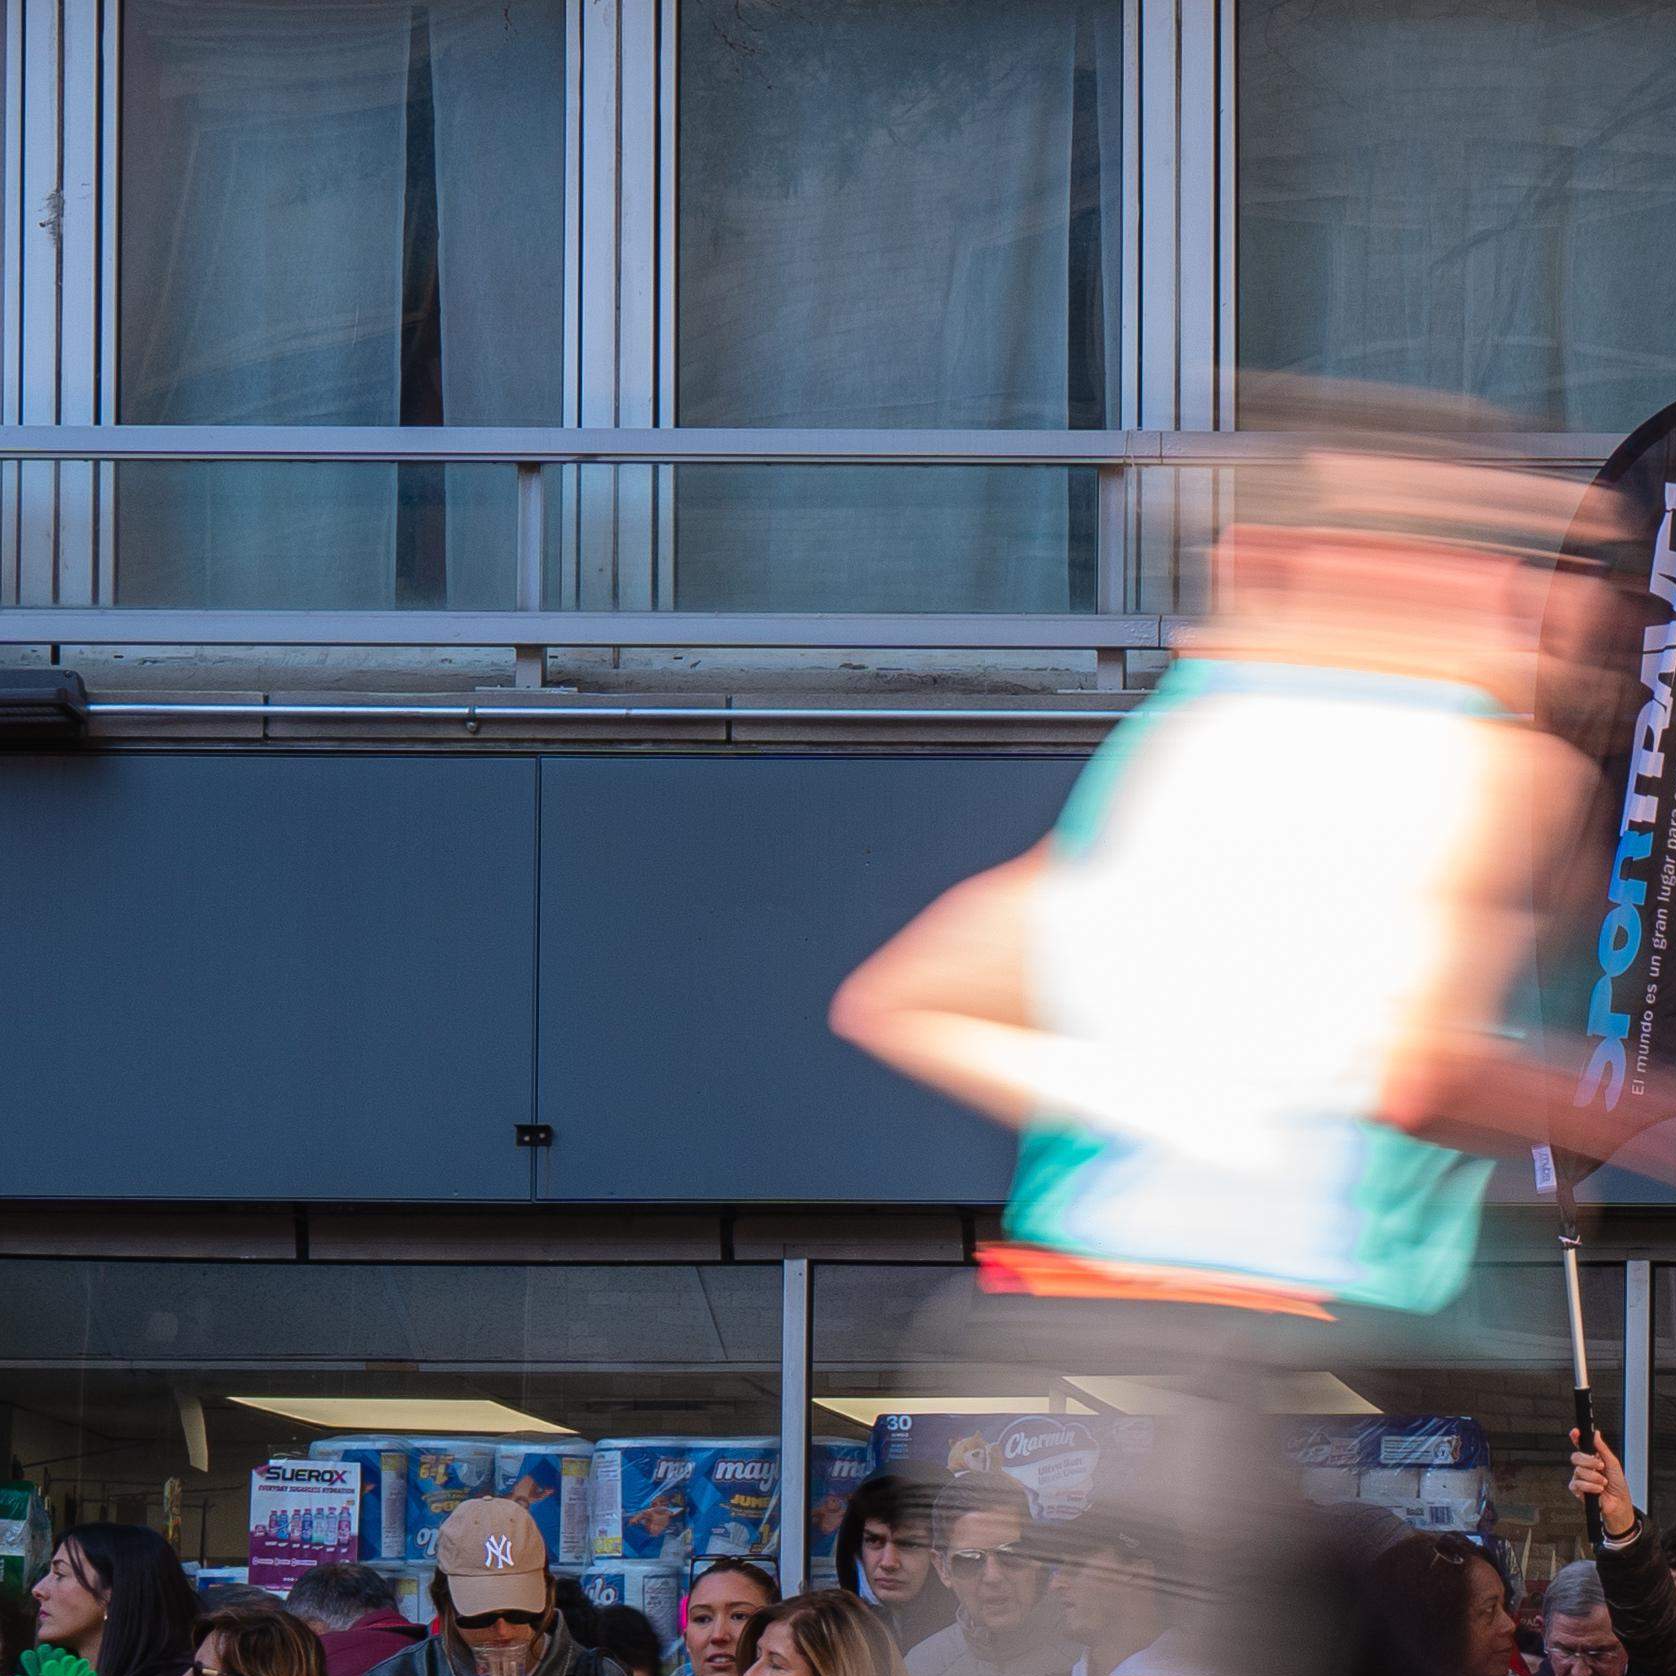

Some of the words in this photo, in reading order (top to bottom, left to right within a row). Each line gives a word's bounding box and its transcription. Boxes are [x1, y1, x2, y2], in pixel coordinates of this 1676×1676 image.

[1657, 855, 1676, 903] lugar
[1652, 908, 1669, 950] gran
[1649, 954, 1662, 978] un
[1645, 983, 1658, 1004] es
[1637, 1010, 1653, 1074] mundo
[1631, 1078, 1645, 1096] El
[887, 1415, 912, 1431] 30
[1005, 1430, 1075, 1459] Charmin
[265, 1465, 348, 1485] SUEROX
[484, 1535, 514, 1569] NY
